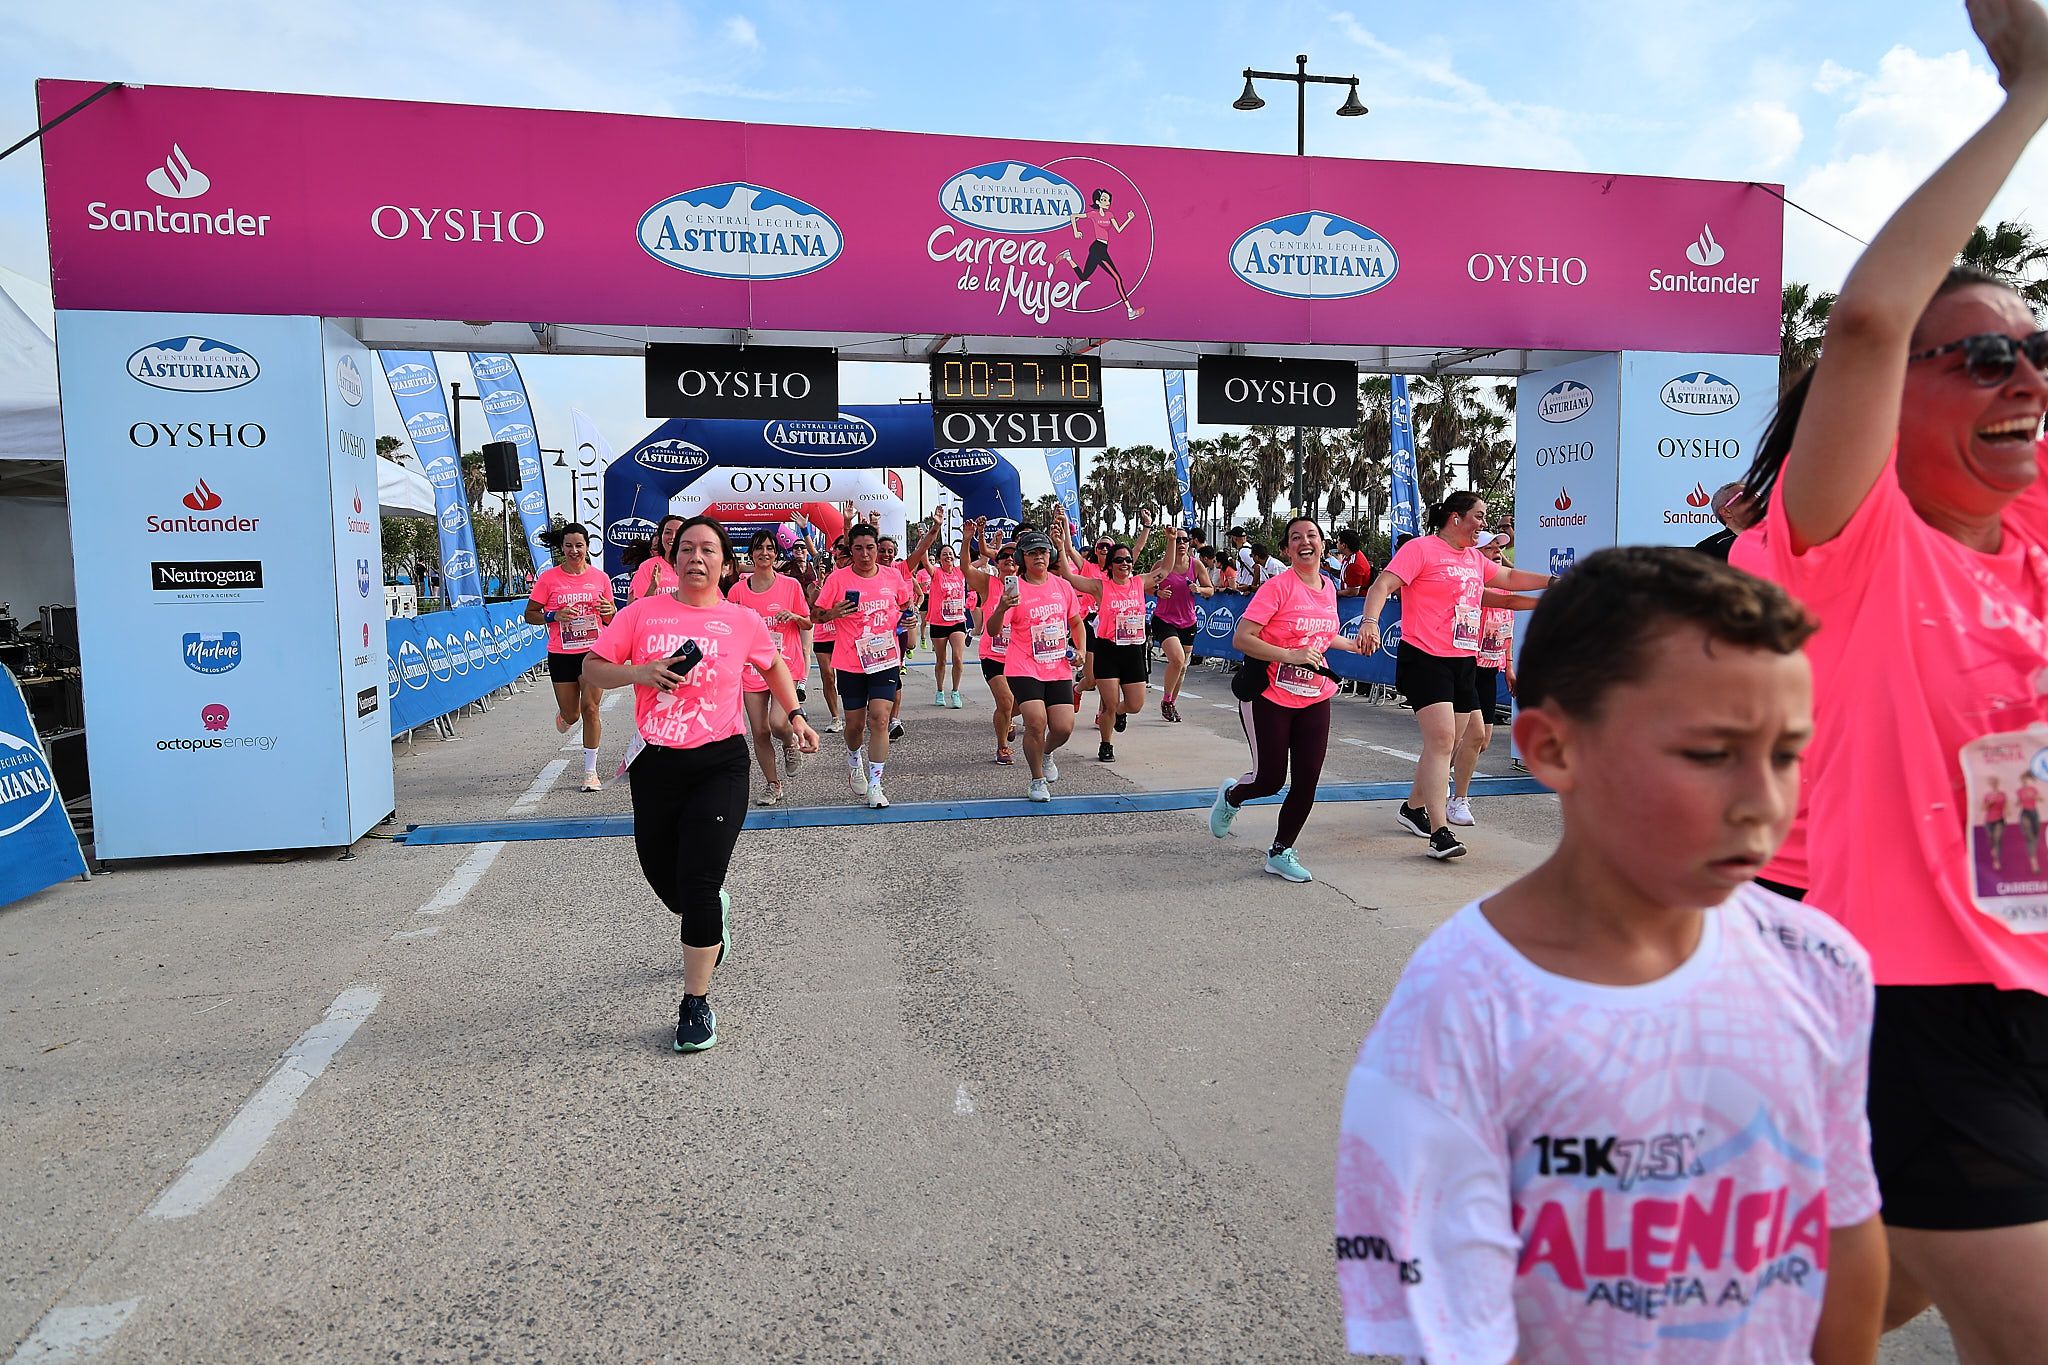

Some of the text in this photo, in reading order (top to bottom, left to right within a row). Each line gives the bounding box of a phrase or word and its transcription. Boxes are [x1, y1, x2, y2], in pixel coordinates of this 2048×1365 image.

[951, 185, 1073, 216] ASTURIANA
[973, 184, 1069, 196] CENTRAL LECHERA
[88, 202, 270, 237] Santander
[370, 205, 545, 245] OYSHO
[685, 214, 821, 229] CENTRAL LECHERA
[654, 215, 828, 257] ASTURIANA
[927, 225, 1047, 266] Carrera
[1270, 241, 1381, 252] CENTRAL LECHERA
[1243, 242, 1386, 278] ASTURIANA
[1467, 253, 1588, 286] OYSHO
[1649, 269, 1760, 295] Santander
[957, 263, 1091, 324] de la Mujer
[137, 356, 251, 379] ASTURIANA
[157, 354, 246, 363] CENTRAL LECHERA
[678, 369, 810, 399] OYSHO
[944, 361, 1090, 399] 00:37:18
[1224, 377, 1336, 408] OYSHO
[1666, 387, 1734, 405] ASTURIANA
[1542, 396, 1589, 416] ASTURIANA
[129, 422, 266, 448] OYSHO
[772, 423, 868, 446] ASTURIANA
[789, 422, 865, 431] CENTRAL LECHERA
[942, 412, 1098, 444] OYSHO
[339, 429, 365, 459] OYSHO
[1536, 441, 1594, 467] OYSHO
[1658, 437, 1740, 459] OYSHO
[639, 446, 703, 465] ASTURIANA
[934, 456, 994, 468] ASTURIANA
[730, 472, 832, 493] OYSHO
[669, 495, 701, 503] OYSHO
[716, 501, 803, 512] Sports Santander
[859, 493, 889, 501] OYSHO
[147, 516, 259, 533] Santander
[1539, 513, 1587, 528] Santander
[160, 568, 256, 586] Neutrogena
[557, 592, 593, 604] CARRERA
[646, 617, 679, 626] OYSHO
[1029, 603, 1063, 619] CARRERA
[1295, 617, 1337, 632] CARRERA
[187, 641, 238, 664] Marlene
[220, 662, 235, 672] ALPES
[1295, 669, 1314, 680] 016
[0, 753, 35, 769] ECHERA
[1533, 1135, 1616, 1177] 15K
[1513, 1177, 1830, 1291] ALENCIA
